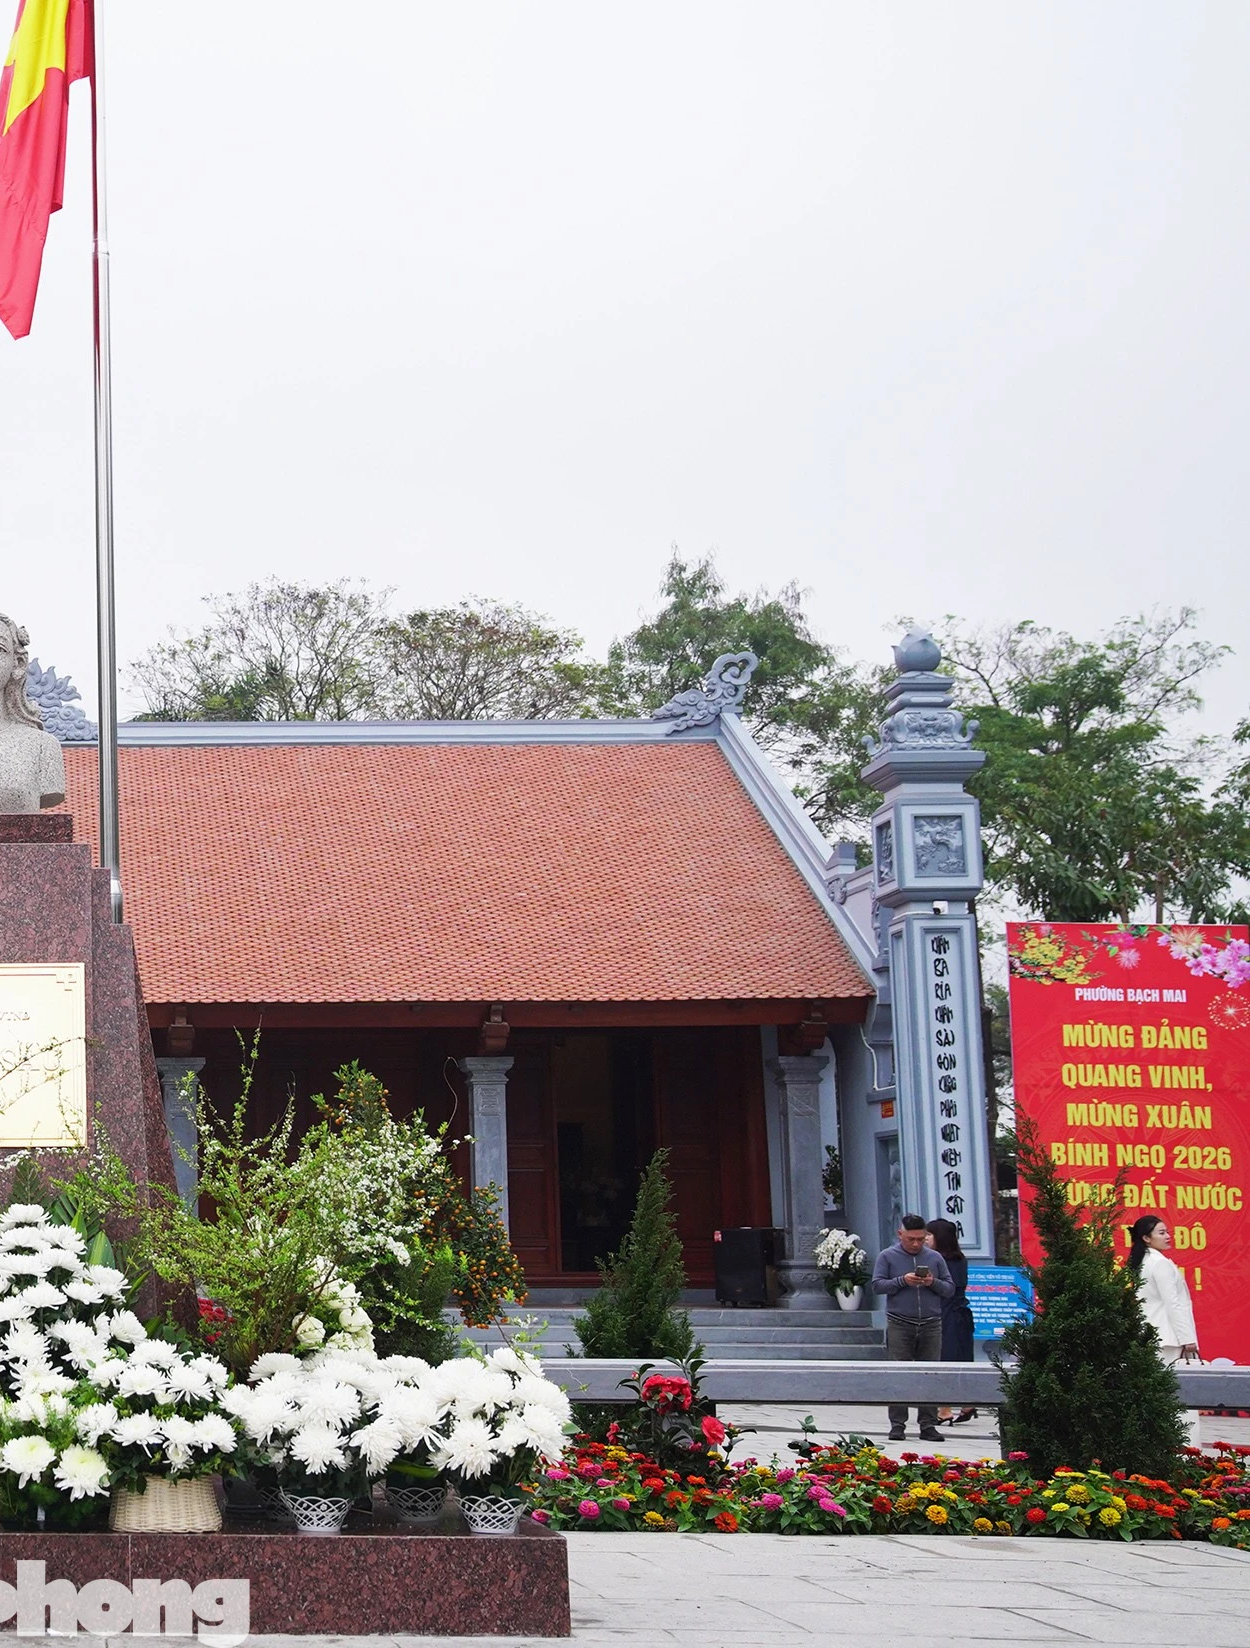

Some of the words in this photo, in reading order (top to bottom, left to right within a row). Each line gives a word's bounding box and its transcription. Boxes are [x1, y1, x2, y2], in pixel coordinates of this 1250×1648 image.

[1075, 985, 1124, 1002] PHƯỜNG
[1127, 988, 1160, 1005] BẠCH
[1163, 989, 1187, 1003] MAI
[1062, 1020, 1134, 1048] MỪNG
[1141, 1018, 1208, 1049] ĐẢNG
[1062, 1063, 1142, 1089] QUANG
[1148, 1065, 1213, 1092] VINH,
[1066, 1099, 1138, 1128] MỪNG
[1146, 1101, 1212, 1129] XUÂN
[1051, 1138, 1108, 1167] BÍNH
[1116, 1144, 1166, 1173] NGỌ
[1173, 1145, 1232, 1170] 2026
[1123, 1176, 1169, 1209] ĐẤT
[1176, 1182, 1243, 1211] NƯỚC
[1174, 1222, 1207, 1250] ĐÔ
